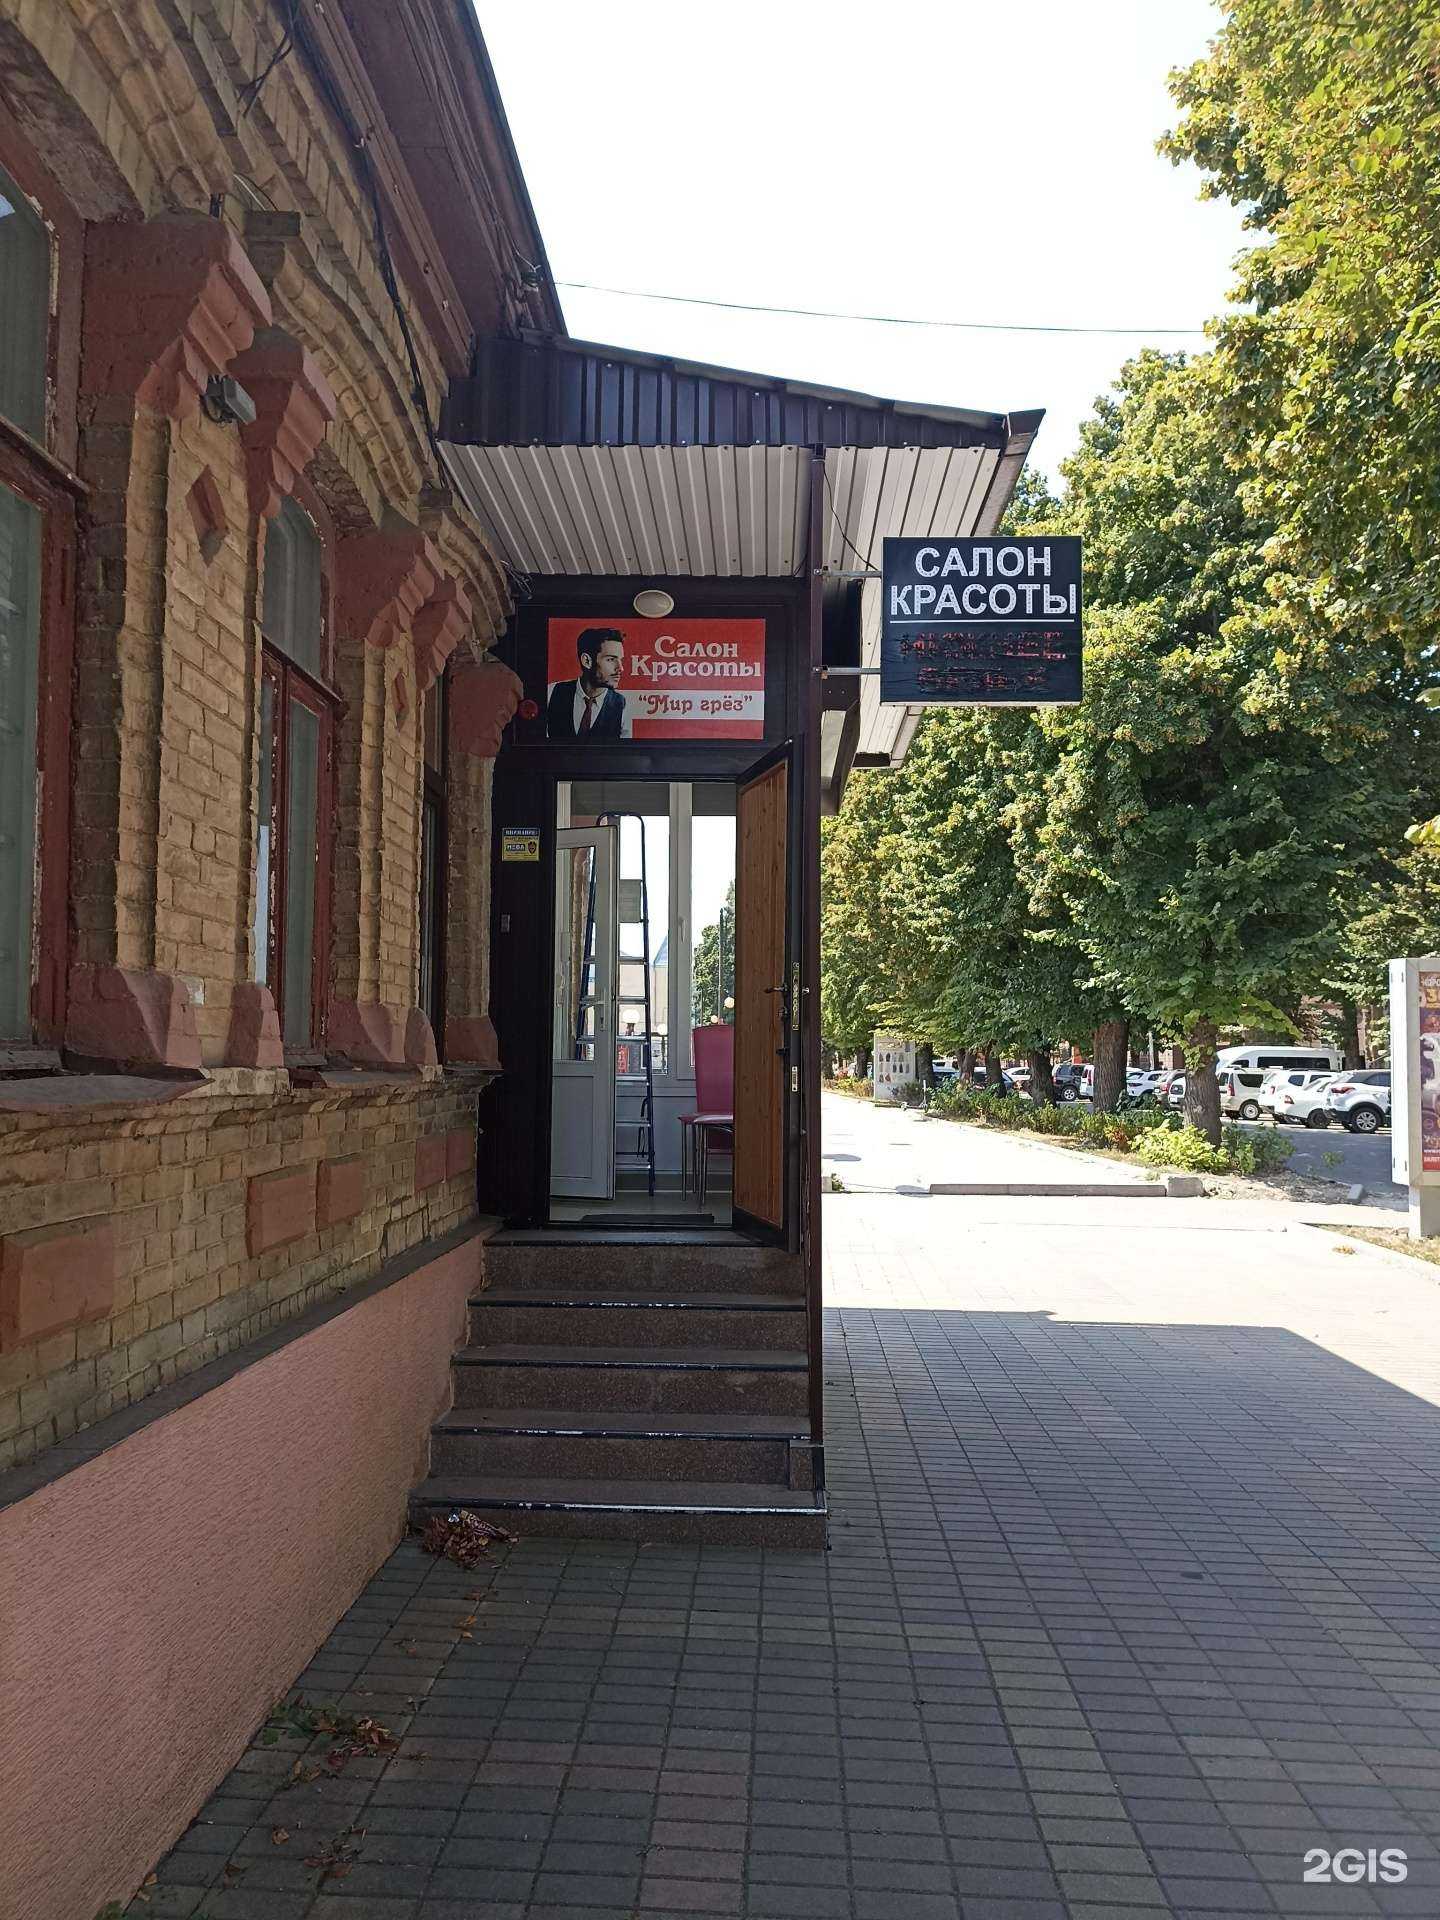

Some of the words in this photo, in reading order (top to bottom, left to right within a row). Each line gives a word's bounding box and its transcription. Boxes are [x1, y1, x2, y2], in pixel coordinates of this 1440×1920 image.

[915, 546, 1051, 577] САЛОН
[890, 583, 1077, 615] КРАСОТЫ
[654, 635, 738, 658] Салон
[631, 654, 761, 681] Красоты
